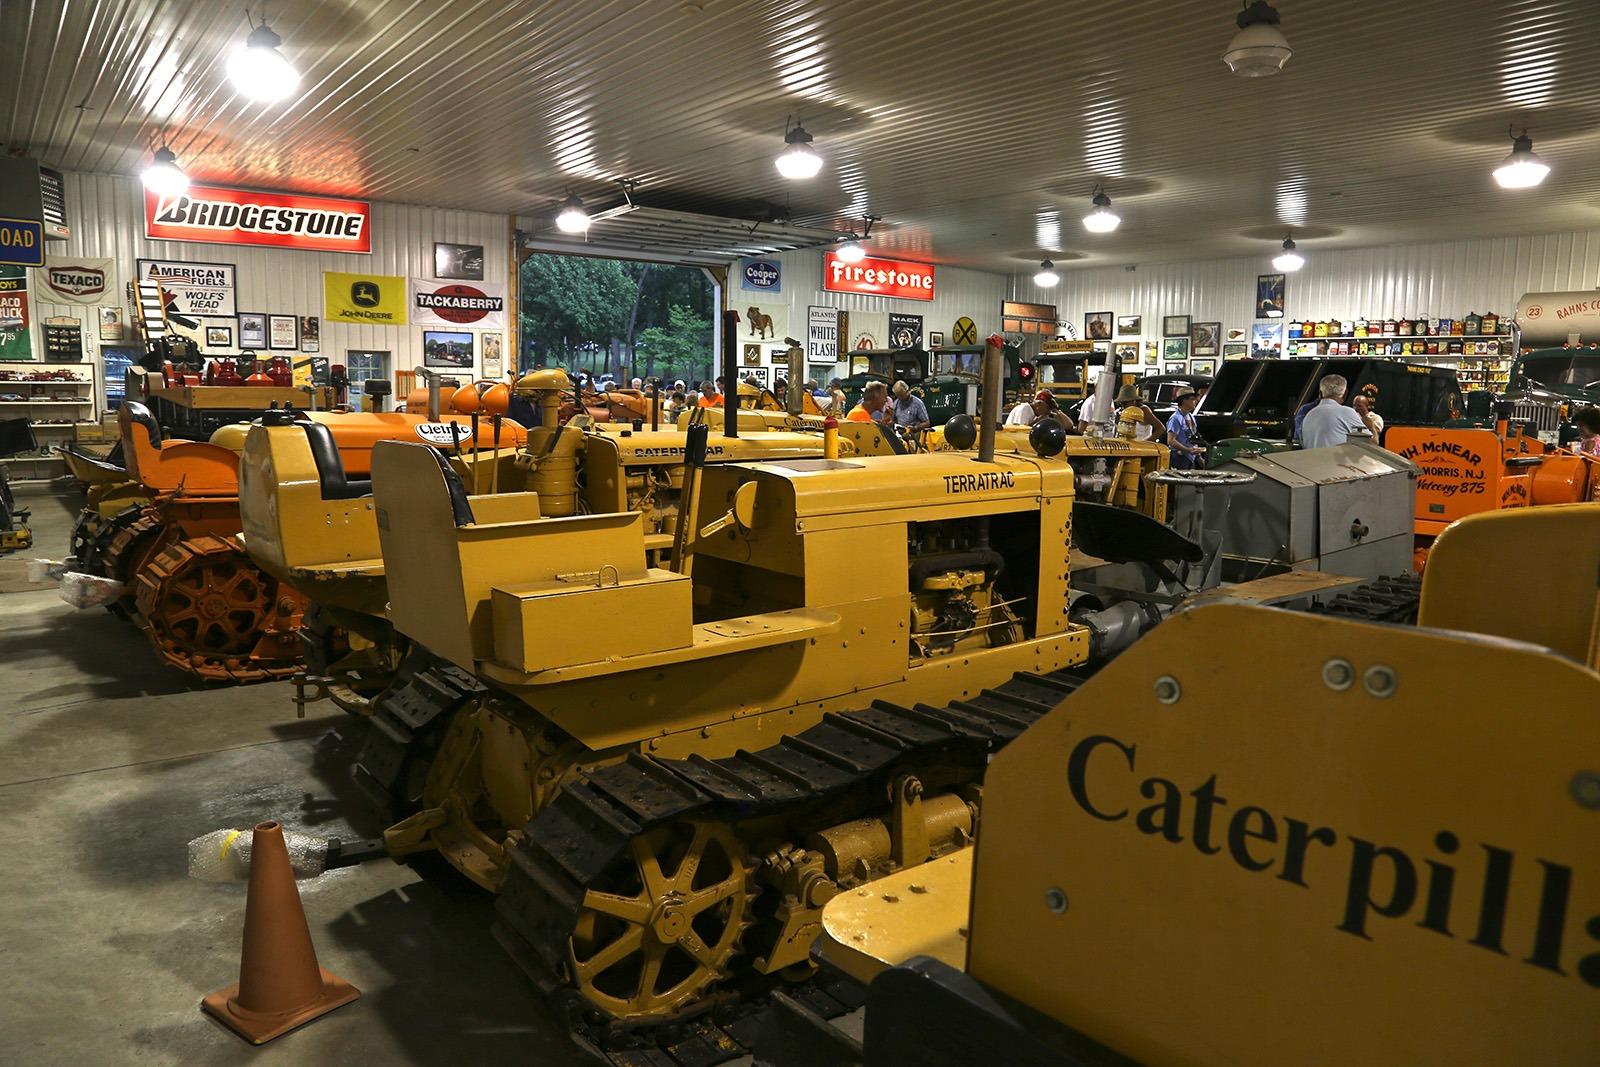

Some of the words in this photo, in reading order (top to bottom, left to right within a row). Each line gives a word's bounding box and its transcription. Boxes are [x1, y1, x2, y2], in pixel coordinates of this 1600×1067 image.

[156, 196, 362, 238] BRIDGESTONE
[149, 264, 225, 279] AMERICAN
[746, 267, 778, 284] Cooper
[830, 260, 933, 289] Firestone
[52, 272, 101, 287] TEXACO
[191, 278, 226, 287] FUELS
[0, 298, 21, 307] ACO
[185, 291, 225, 301] WOLF'S
[417, 294, 502, 310] TACKABERRY
[189, 301, 220, 309] HEAD
[1528, 307, 1540, 316] 23
[1556, 302, 1588, 320] RAHNS
[810, 310, 836, 319] ATLANTIC
[810, 325, 836, 340] WHITE
[810, 342, 836, 357] FLASH
[634, 446, 725, 458] CATERPAR
[1421, 441, 1482, 466] McNEAR
[943, 470, 1015, 494] TERRATRAC
[1459, 481, 1486, 495] 875
